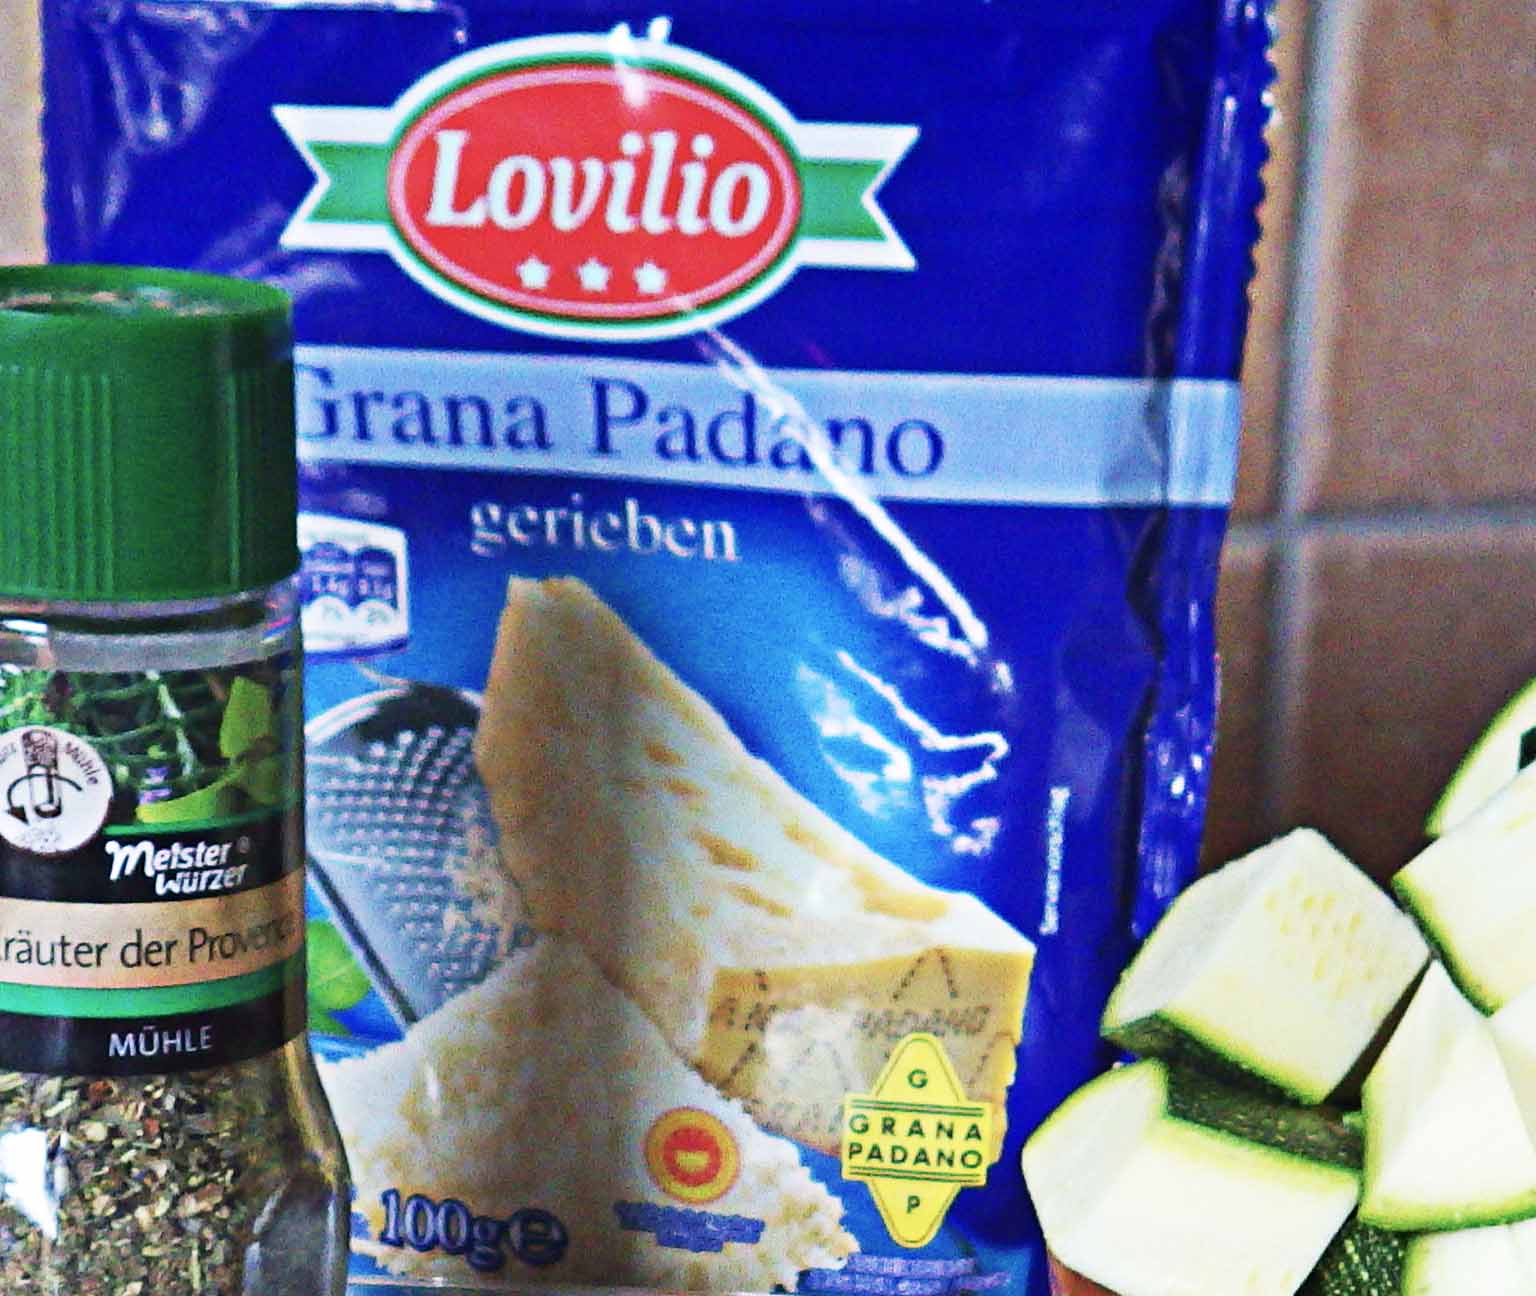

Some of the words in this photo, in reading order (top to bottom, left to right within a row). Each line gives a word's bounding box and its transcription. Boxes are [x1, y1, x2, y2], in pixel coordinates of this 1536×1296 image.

[426, 128, 770, 240] Lovilio
[296, 364, 553, 453] Grana
[590, 374, 946, 479] Padano
[468, 492, 741, 564] gerieben
[104, 839, 233, 881] Meister
[120, 927, 178, 969] der
[107, 1024, 214, 1058] MÜHLE
[907, 1068, 929, 1089] G
[849, 1114, 982, 1141] GRANA
[848, 1142, 983, 1169] PADANO
[906, 1195, 921, 1214] P
